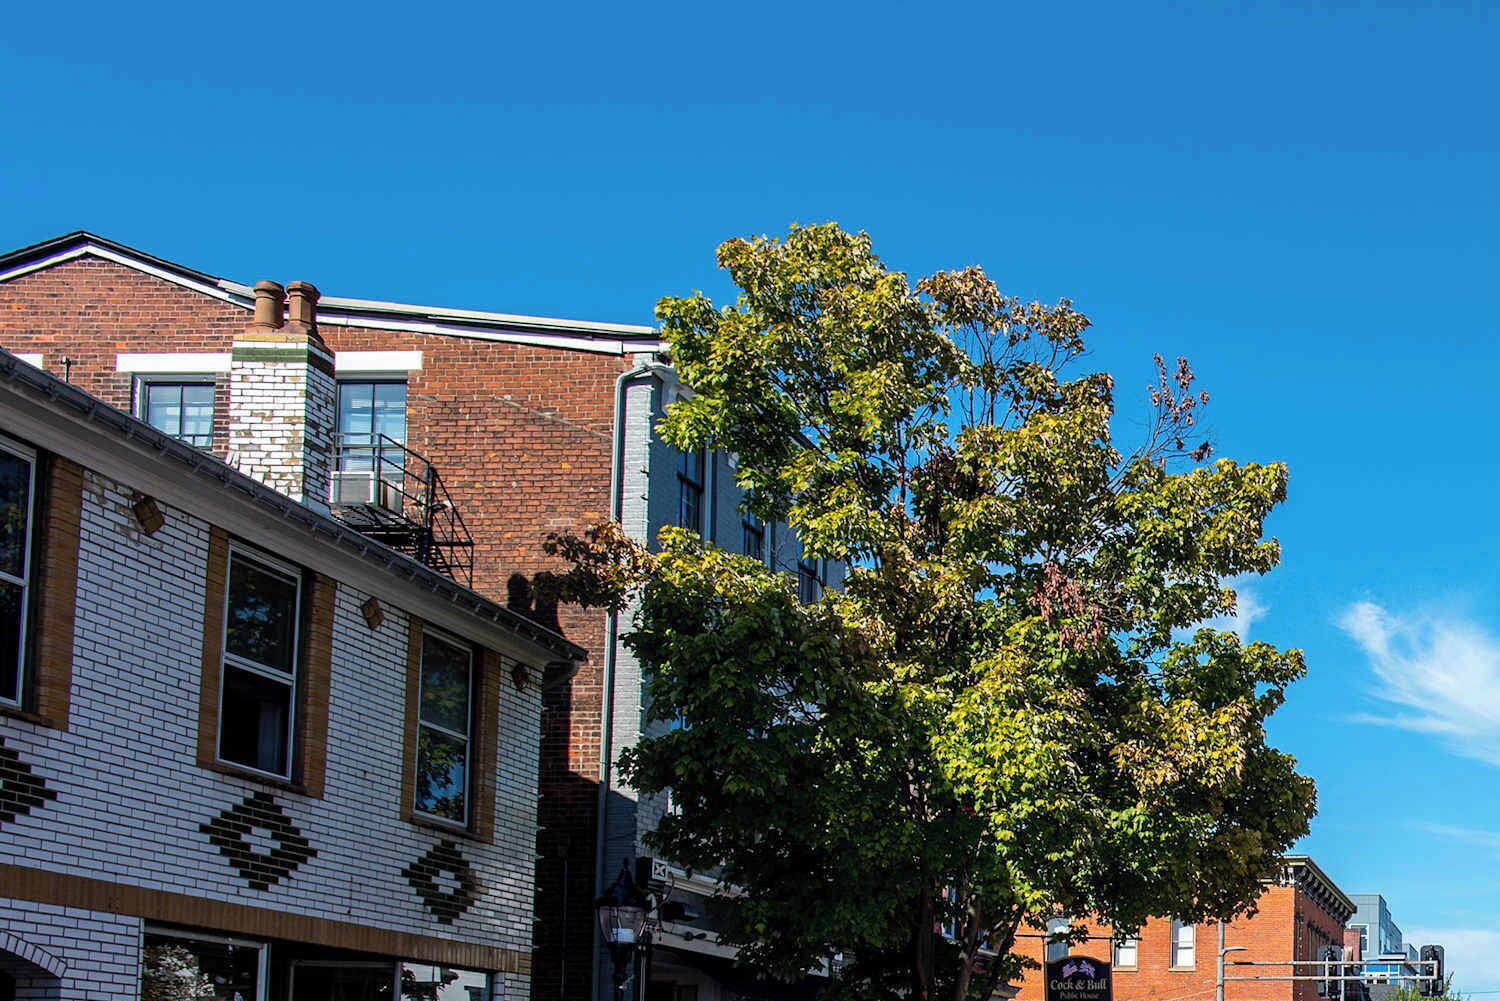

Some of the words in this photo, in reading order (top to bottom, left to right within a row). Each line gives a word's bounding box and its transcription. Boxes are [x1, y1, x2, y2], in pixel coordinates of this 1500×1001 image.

[1051, 978, 1075, 990] Cock
[1075, 979, 1086, 990] &
[1087, 978, 1107, 990] Bull
